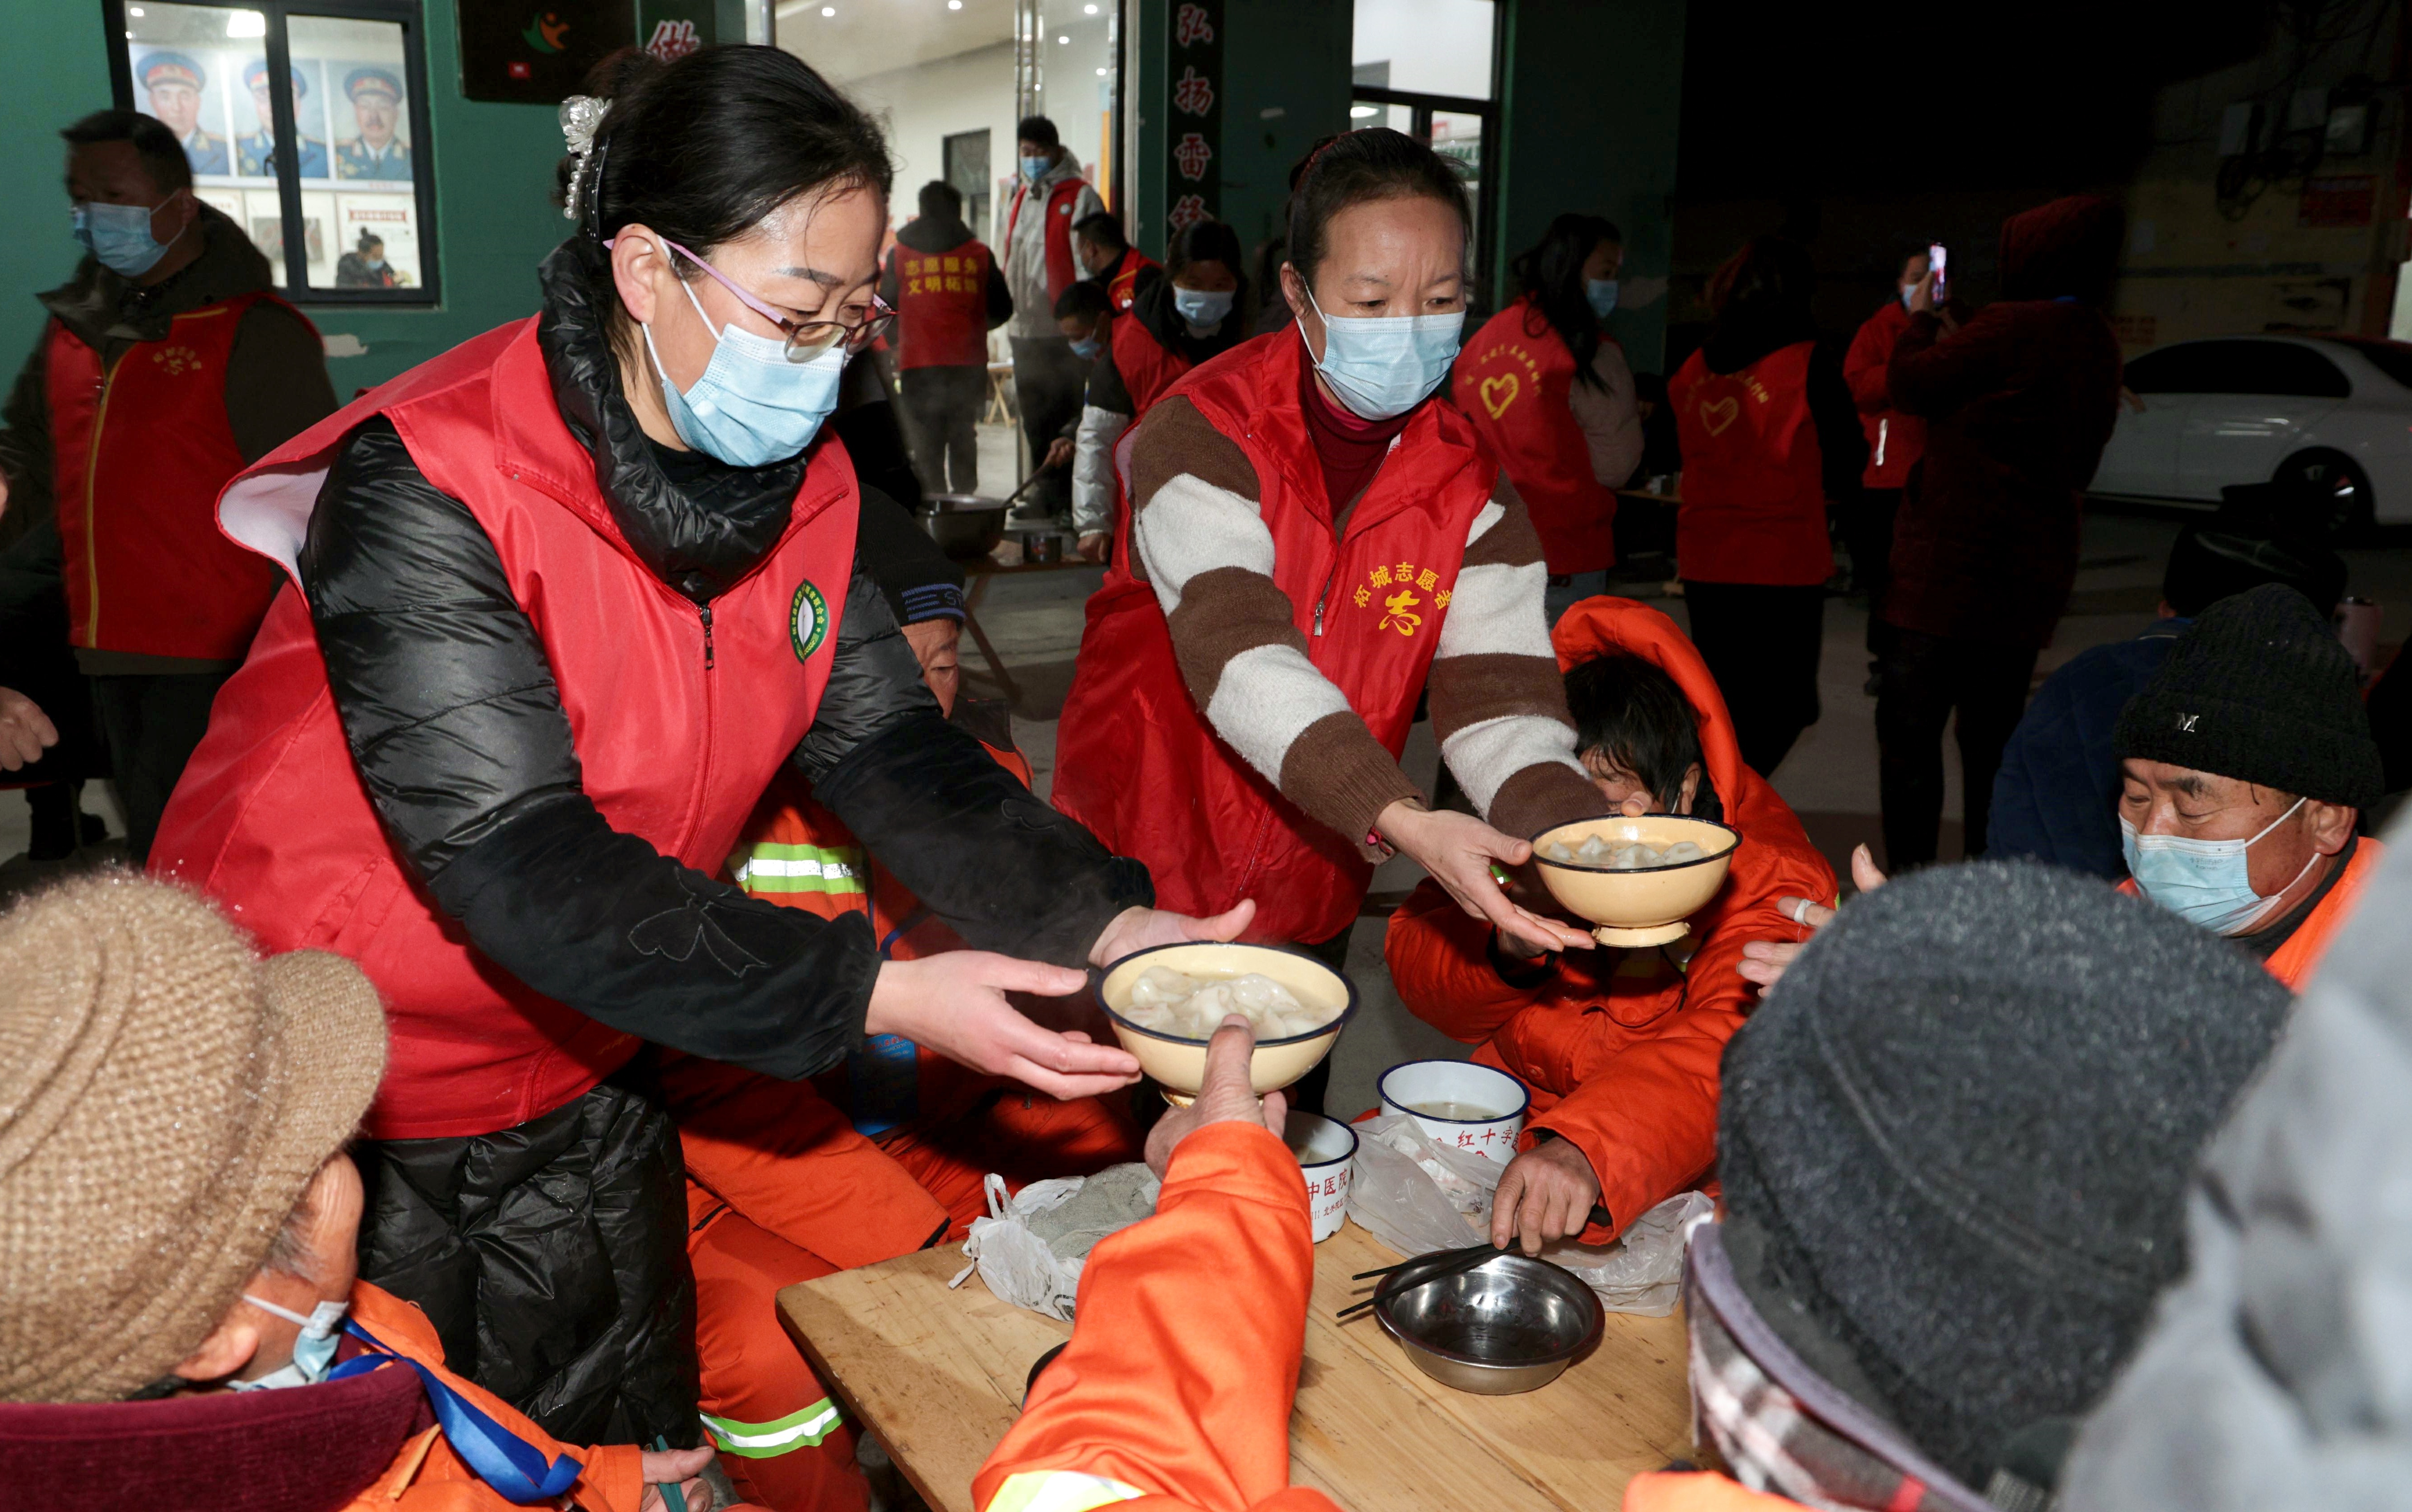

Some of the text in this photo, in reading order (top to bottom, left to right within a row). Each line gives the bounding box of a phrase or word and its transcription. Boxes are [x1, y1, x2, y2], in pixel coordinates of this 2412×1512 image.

[1353, 562, 1452, 610] 柘城志愿者
[2177, 712, 2199, 732] M
[1308, 1168, 1347, 1201] 中医院
